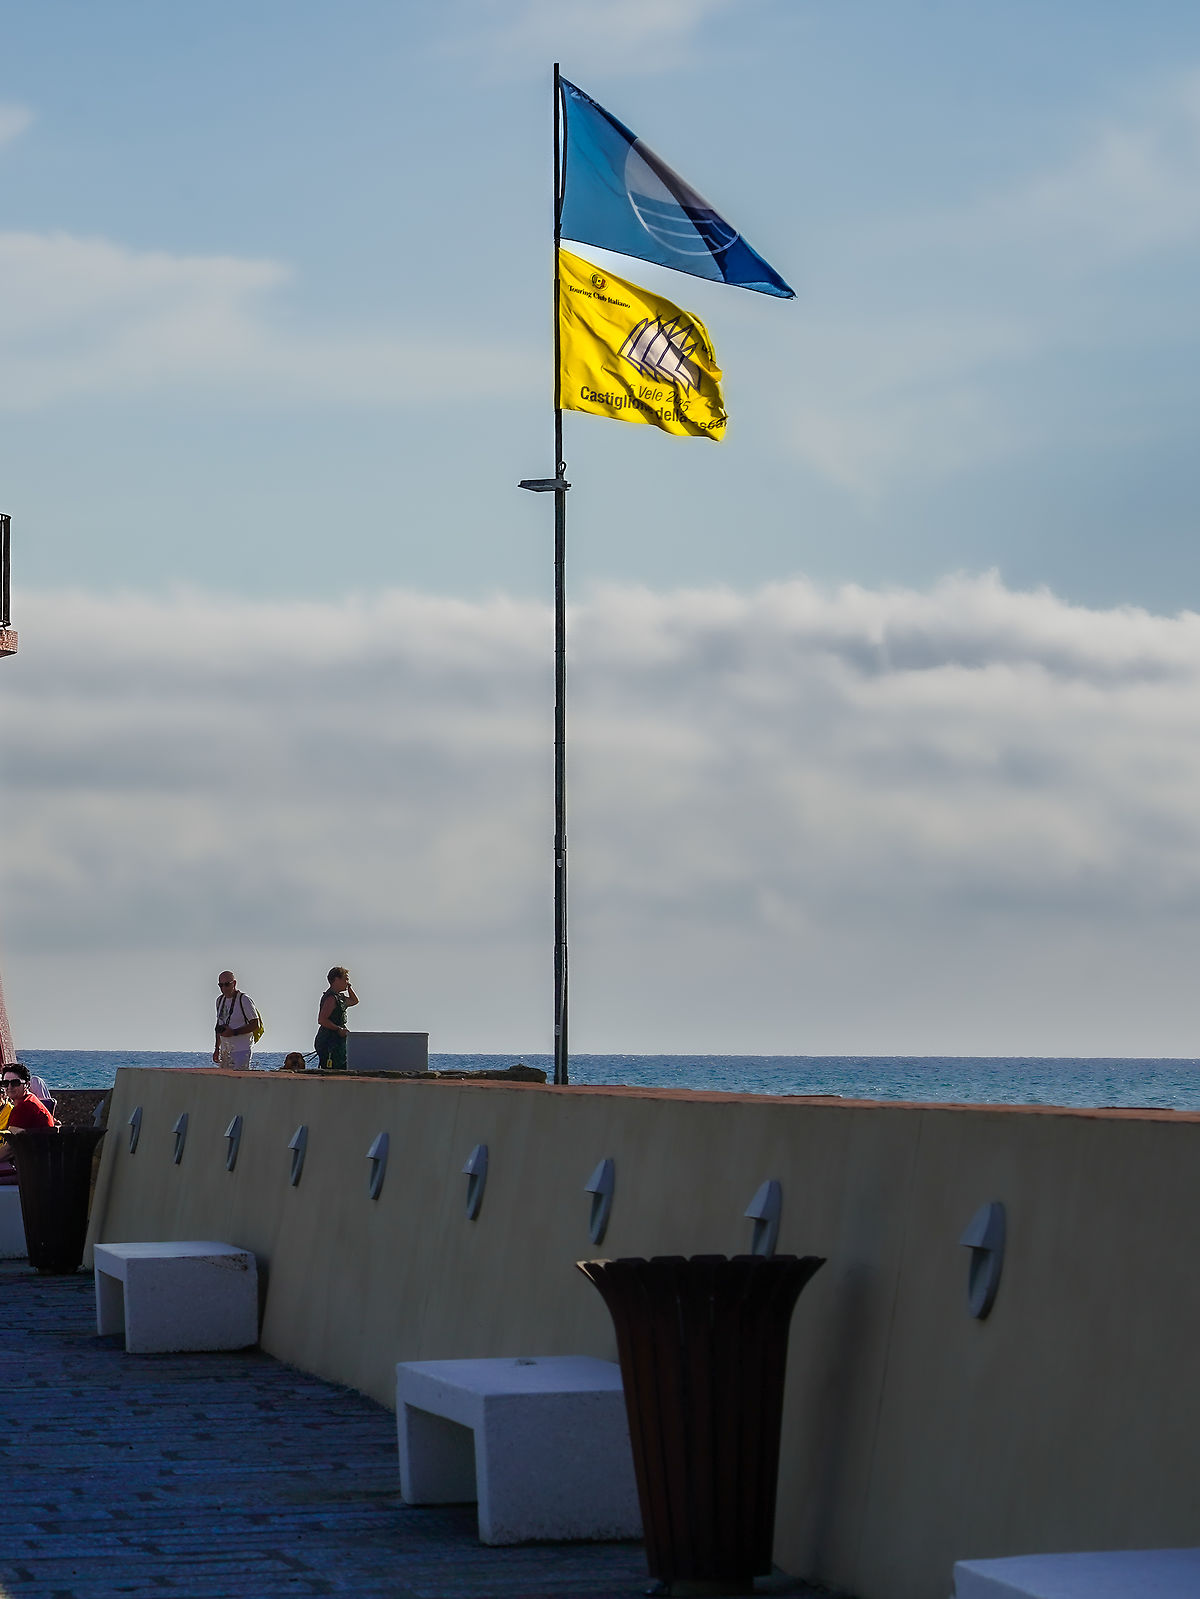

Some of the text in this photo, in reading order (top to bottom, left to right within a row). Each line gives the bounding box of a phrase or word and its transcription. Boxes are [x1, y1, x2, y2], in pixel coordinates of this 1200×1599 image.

[568, 284, 631, 308] Touring Club Italiano
[580, 386, 654, 414] Castiglio
[638, 386, 664, 402] Vele
